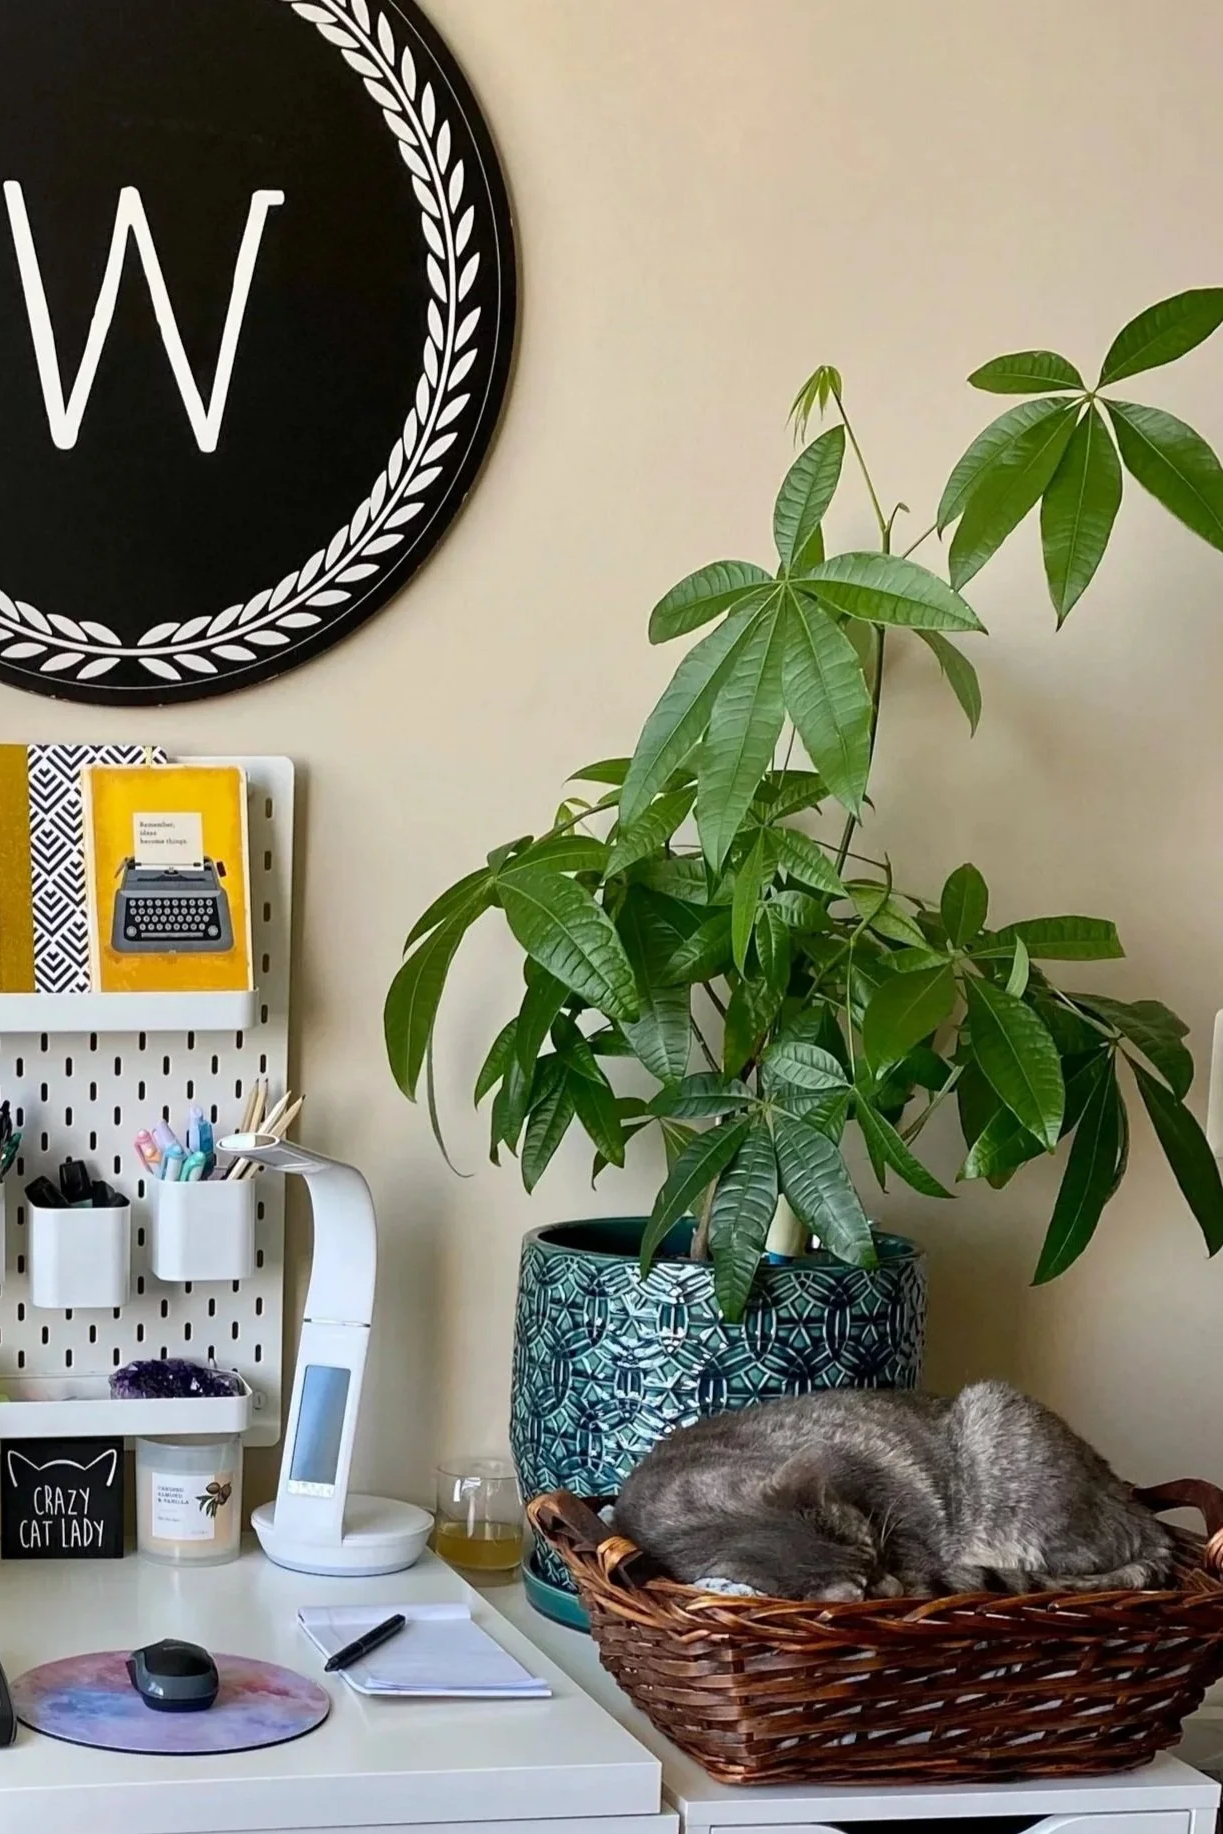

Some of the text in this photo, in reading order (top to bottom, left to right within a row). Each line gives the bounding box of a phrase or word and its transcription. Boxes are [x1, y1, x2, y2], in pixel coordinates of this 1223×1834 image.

[3, 180, 285, 453] W
[33, 1485, 90, 1515] CRAZY
[19, 1518, 104, 1548] CAT LADY
